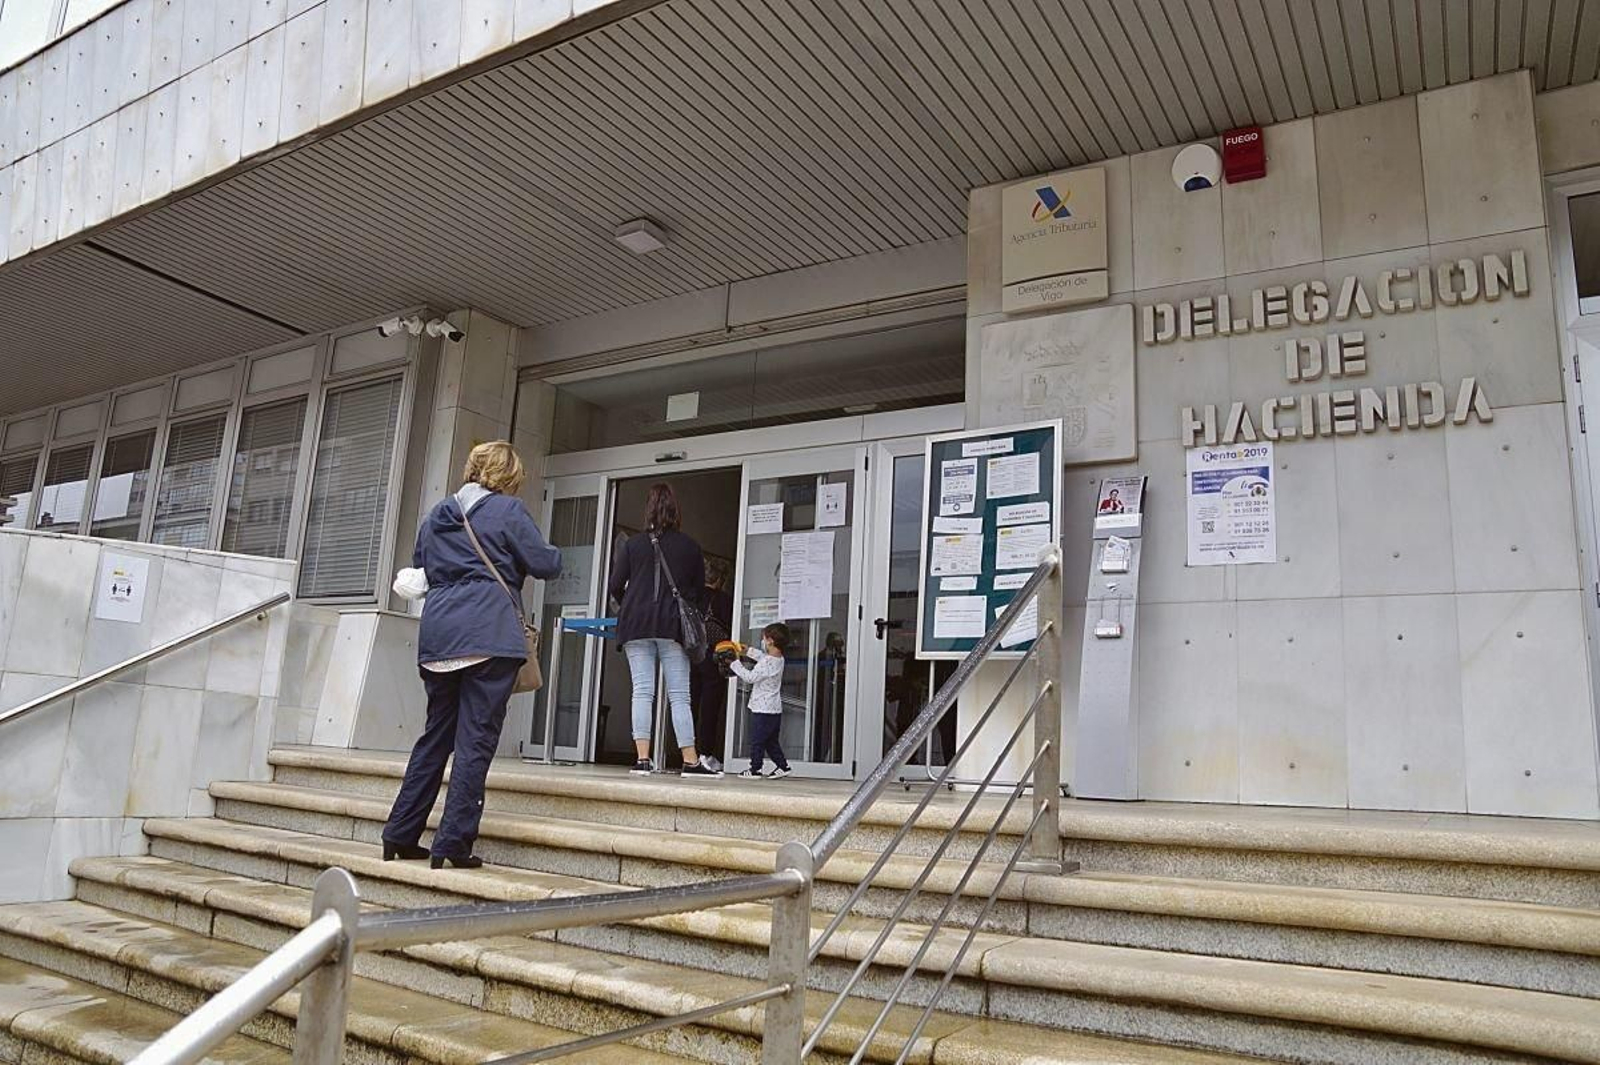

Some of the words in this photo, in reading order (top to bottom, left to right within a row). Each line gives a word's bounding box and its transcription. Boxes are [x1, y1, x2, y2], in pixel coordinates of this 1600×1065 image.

[1226, 132, 1258, 146] FUEGO
[1012, 229, 1047, 245] Agencia
[1049, 220, 1097, 235] Tributaria
[1018, 279, 1072, 295] Delegación
[1074, 277, 1088, 286] de
[1040, 292, 1063, 302] Vigo
[1142, 249, 1530, 346] DELEGACION
[1284, 330, 1367, 383] DE
[1182, 377, 1494, 449] HACIENDA
[1202, 451, 1237, 462] Renta
[1243, 447, 1268, 458] 2019
